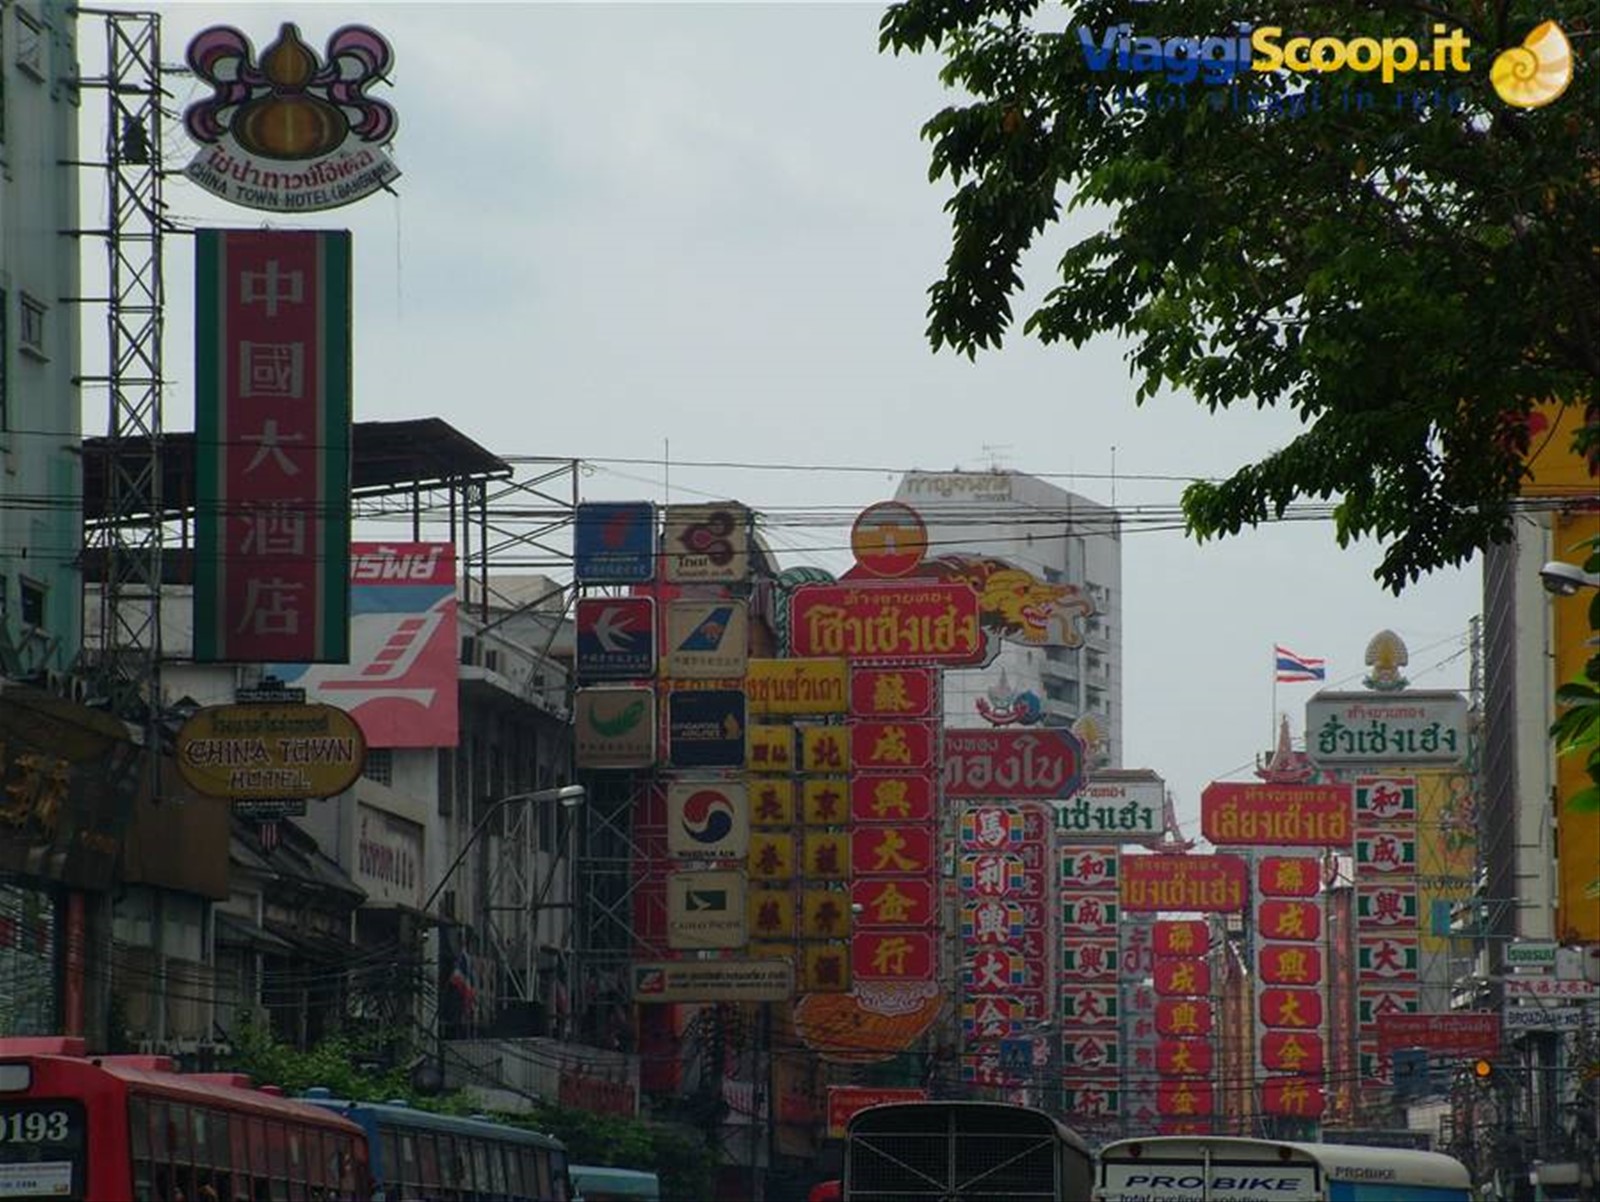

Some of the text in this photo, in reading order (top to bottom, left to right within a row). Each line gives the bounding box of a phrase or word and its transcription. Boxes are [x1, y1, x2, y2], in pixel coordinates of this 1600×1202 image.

[189, 163, 227, 195] CHINA
[236, 186, 279, 206] TOWN
[285, 190, 331, 208] HOTEL
[236, 260, 305, 636] 中國大酒店
[185, 737, 355, 767] CHINA TOWN
[228, 768, 311, 790] HOTEL
[1334, 1166, 1396, 1180] PROBIKE
